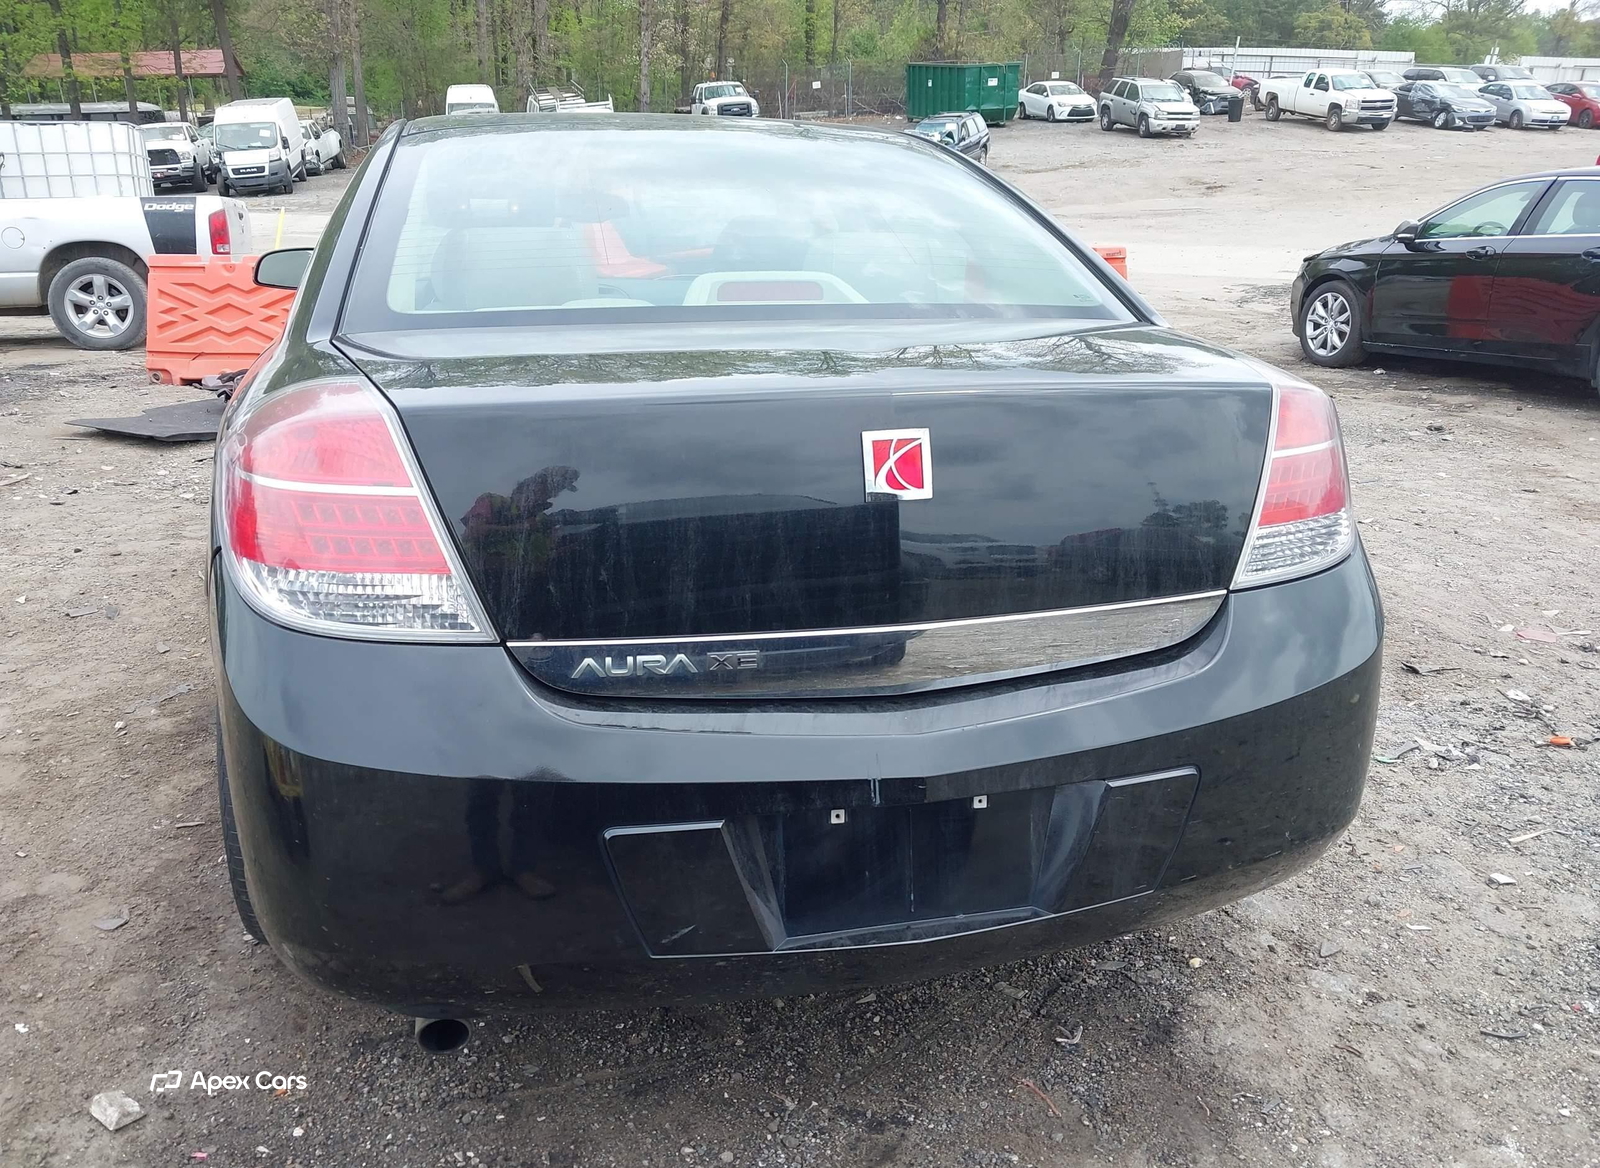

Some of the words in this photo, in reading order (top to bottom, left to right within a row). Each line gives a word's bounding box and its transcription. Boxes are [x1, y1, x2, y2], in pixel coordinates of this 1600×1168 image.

[144, 202, 194, 212] Dodge
[571, 653, 699, 679] AURA
[709, 653, 758, 671] XE
